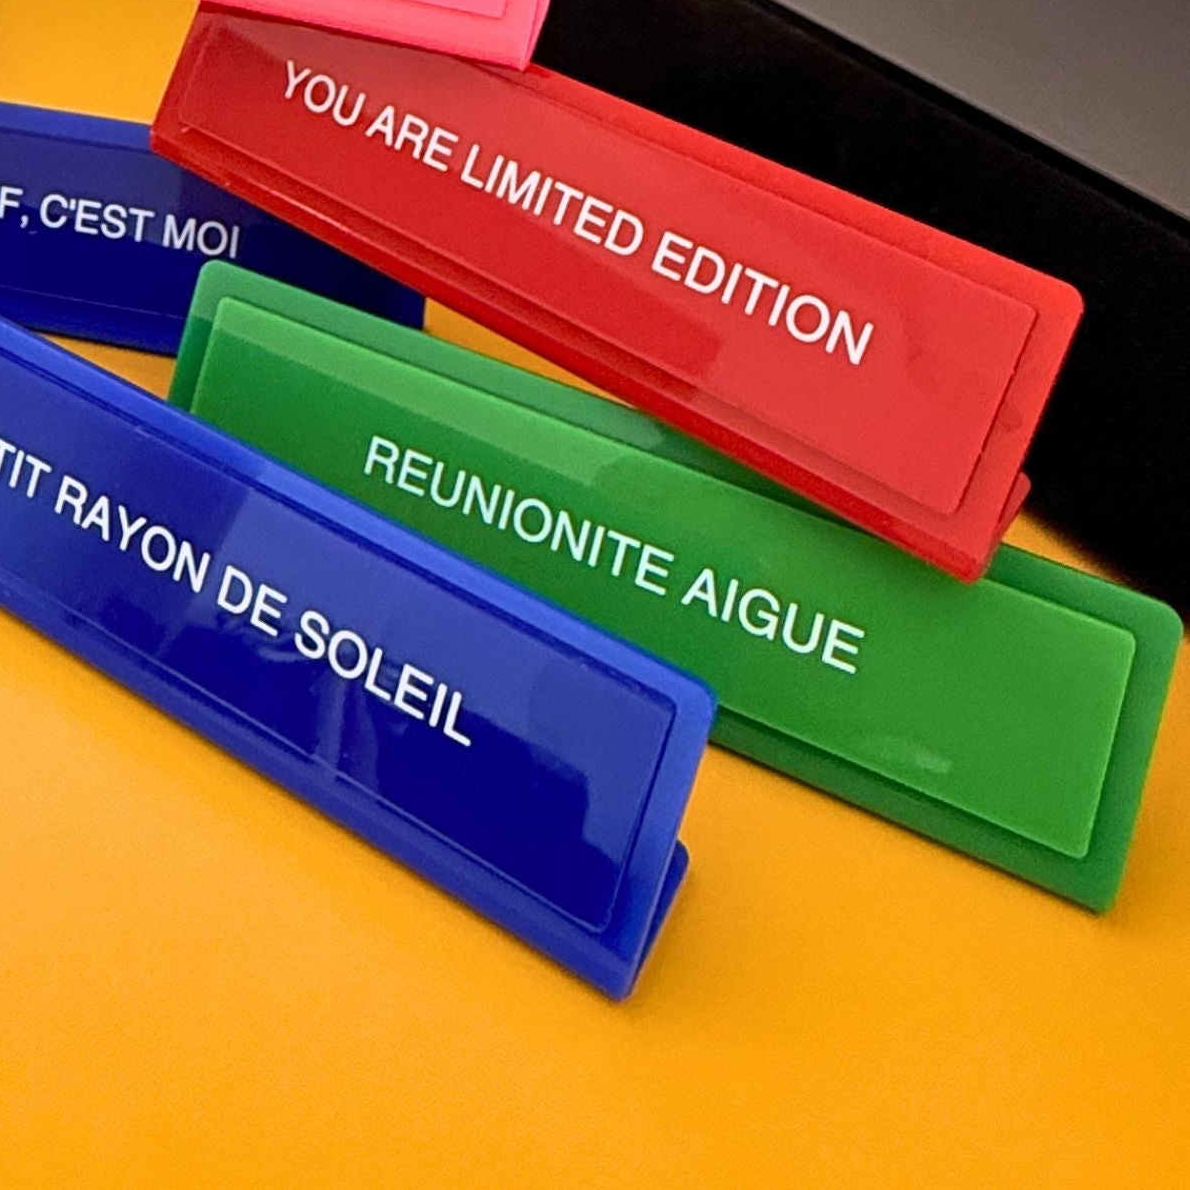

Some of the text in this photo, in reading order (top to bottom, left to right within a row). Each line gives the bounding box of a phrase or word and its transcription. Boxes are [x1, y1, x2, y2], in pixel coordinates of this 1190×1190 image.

[39, 194, 155, 242] C'EST
[162, 214, 240, 259] MOI
[284, 60, 874, 366] YOU ARE LIMITED EDITION
[54, 475, 210, 593] RAYON
[217, 565, 287, 637] DE
[294, 610, 472, 747] SOLEIL
[363, 435, 865, 675] REUNIONITE AIGUE
